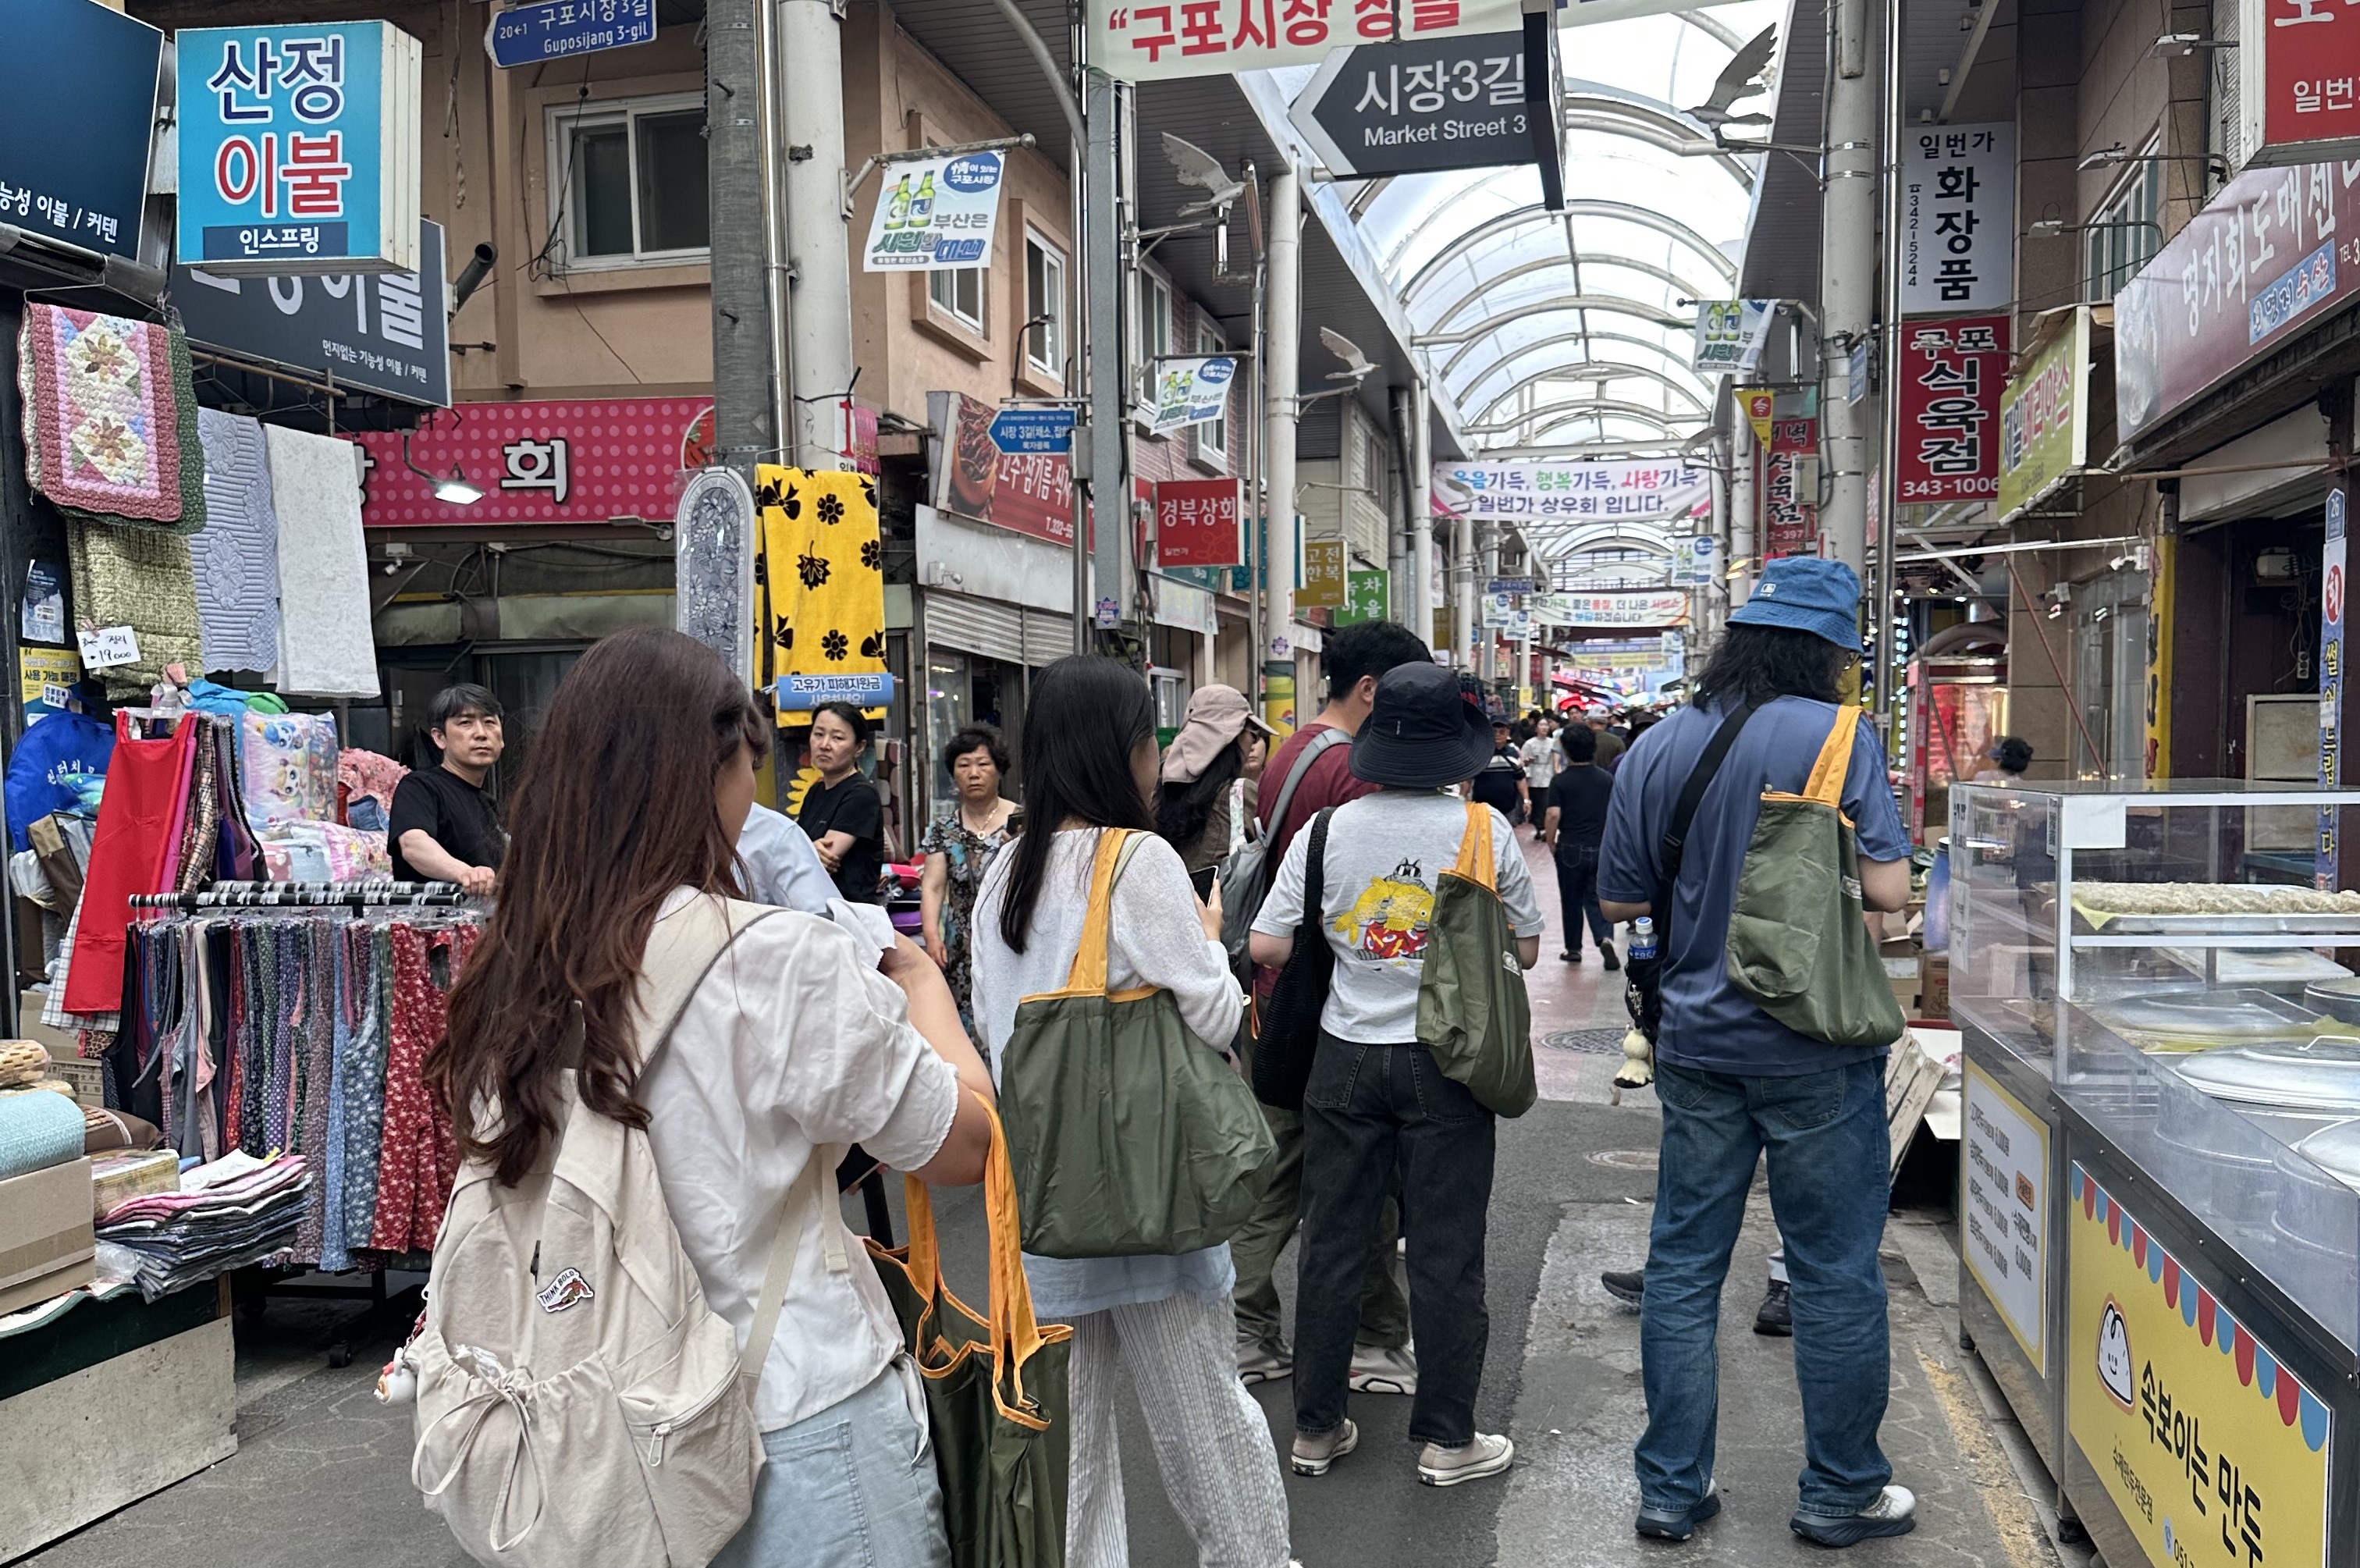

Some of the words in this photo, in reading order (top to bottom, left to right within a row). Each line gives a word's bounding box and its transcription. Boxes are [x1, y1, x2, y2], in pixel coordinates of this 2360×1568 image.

[499, 27, 514, 39] 20
[544, 30, 613, 54] Guposijang
[617, 22, 648, 41] 3-gil
[208, 34, 343, 124] 산정
[1356, 54, 1526, 117] 시장3길
[2293, 76, 2360, 113] 일번
[1363, 123, 1438, 148] Market
[1443, 117, 1507, 141] Street
[1512, 114, 1527, 134] 3
[1919, 130, 1996, 159] 일번가
[215, 130, 352, 219] 이불
[951, 175, 996, 185] 구포시장
[37, 195, 69, 229] 이불
[87, 212, 119, 244] 커텐
[933, 213, 989, 229] 부산은
[1932, 165, 1981, 303] 화장품
[239, 226, 320, 255] 인스프링
[872, 231, 943, 253] 시원한
[1907, 194, 1921, 287] 342-5244
[2339, 244, 2351, 265] TEL
[322, 339, 357, 364] 먼지없는
[359, 349, 385, 371] 기능성
[386, 357, 403, 377] 이불
[1910, 326, 1998, 361] 구포
[1916, 356, 1989, 477] 식육점
[1000, 425, 1017, 439] 시장
[1536, 470, 1616, 491] 행복가득,
[1620, 468, 1698, 490] 사랑가득
[1902, 476, 2000, 499] 343-1006
[1160, 496, 1237, 528] 경북상회
[1477, 495, 1534, 514] 일번가
[1541, 496, 1598, 514] 상우회
[1605, 494, 1669, 514] 입니다.
[2330, 496, 2340, 518] 26
[24, 670, 41, 681] 사용
[43, 670, 59, 682] 가능
[791, 677, 826, 692] 고유가
[827, 676, 882, 692] 피해지원금
[538, 1283, 560, 1305] THINK
[2141, 1359, 2209, 1516] 속보이는
[2218, 1452, 2263, 1568] 만두
[2113, 1445, 2153, 1526] 수제만두전문점
